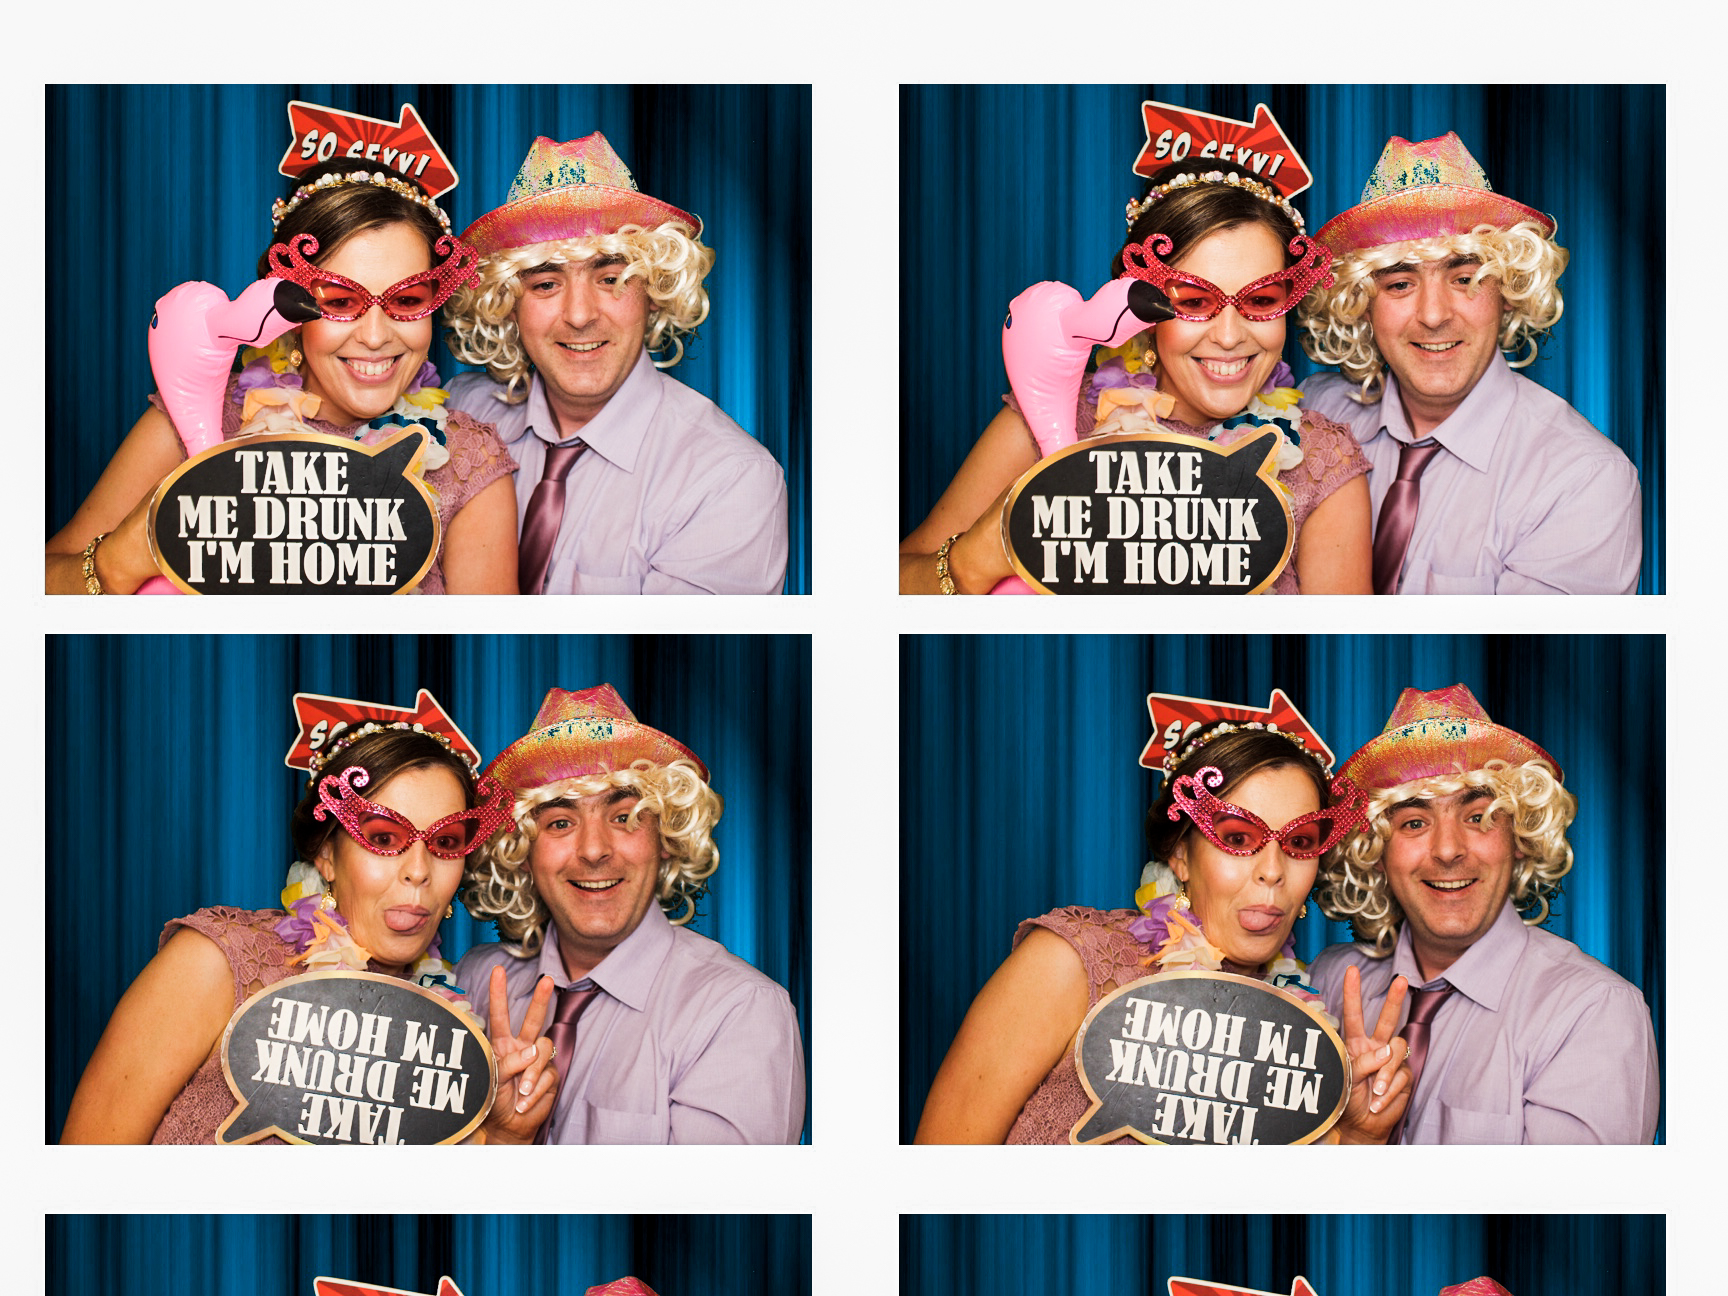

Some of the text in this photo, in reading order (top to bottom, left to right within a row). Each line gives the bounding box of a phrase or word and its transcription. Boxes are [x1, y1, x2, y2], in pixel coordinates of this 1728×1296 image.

[300, 129, 338, 162] SO
[1154, 129, 1192, 162] SO
[234, 450, 349, 495] TAKE
[1088, 450, 1203, 495] TAKE
[177, 495, 408, 541] ME DRUNK
[1031, 495, 1262, 541] ME DRUNK
[187, 540, 398, 586] I'M HOME
[1041, 540, 1252, 586] I'M HOME
[267, 997, 468, 1070] I'M HOME
[1121, 997, 1322, 1070] I'M HOME
[251, 1038, 470, 1114] ME DRUNK
[1105, 1038, 1324, 1114] ME DRUNK
[298, 1092, 405, 1145] TAKE
[1152, 1092, 1259, 1145] TAKE
